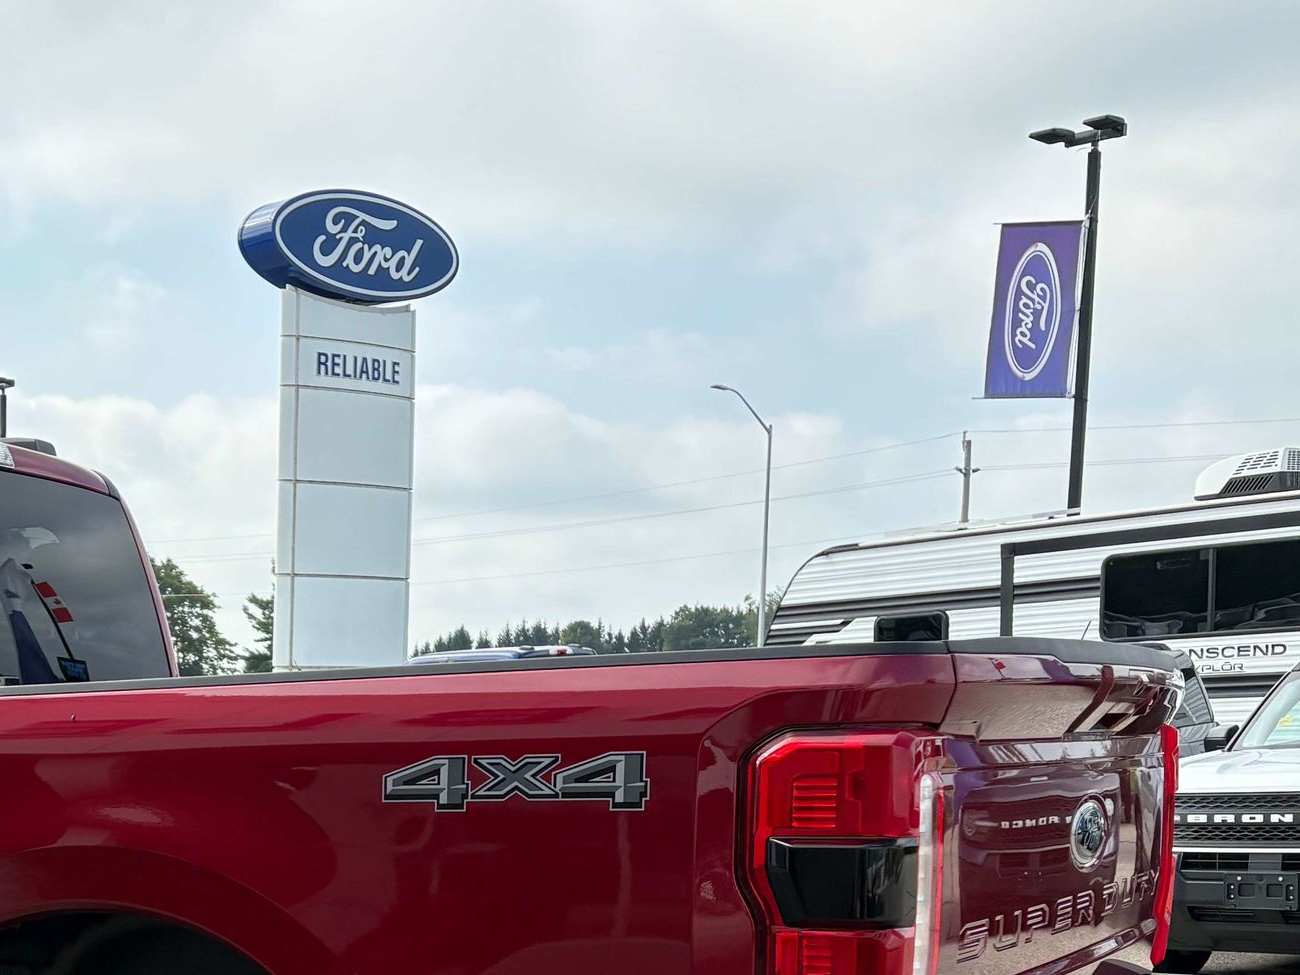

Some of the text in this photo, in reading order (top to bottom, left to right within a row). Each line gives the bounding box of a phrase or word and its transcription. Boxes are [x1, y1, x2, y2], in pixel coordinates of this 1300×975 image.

[313, 206, 424, 282] Ford
[1015, 275, 1050, 349] Ford
[316, 351, 400, 384] RELIABLE
[956, 889, 1096, 964] SUPER
